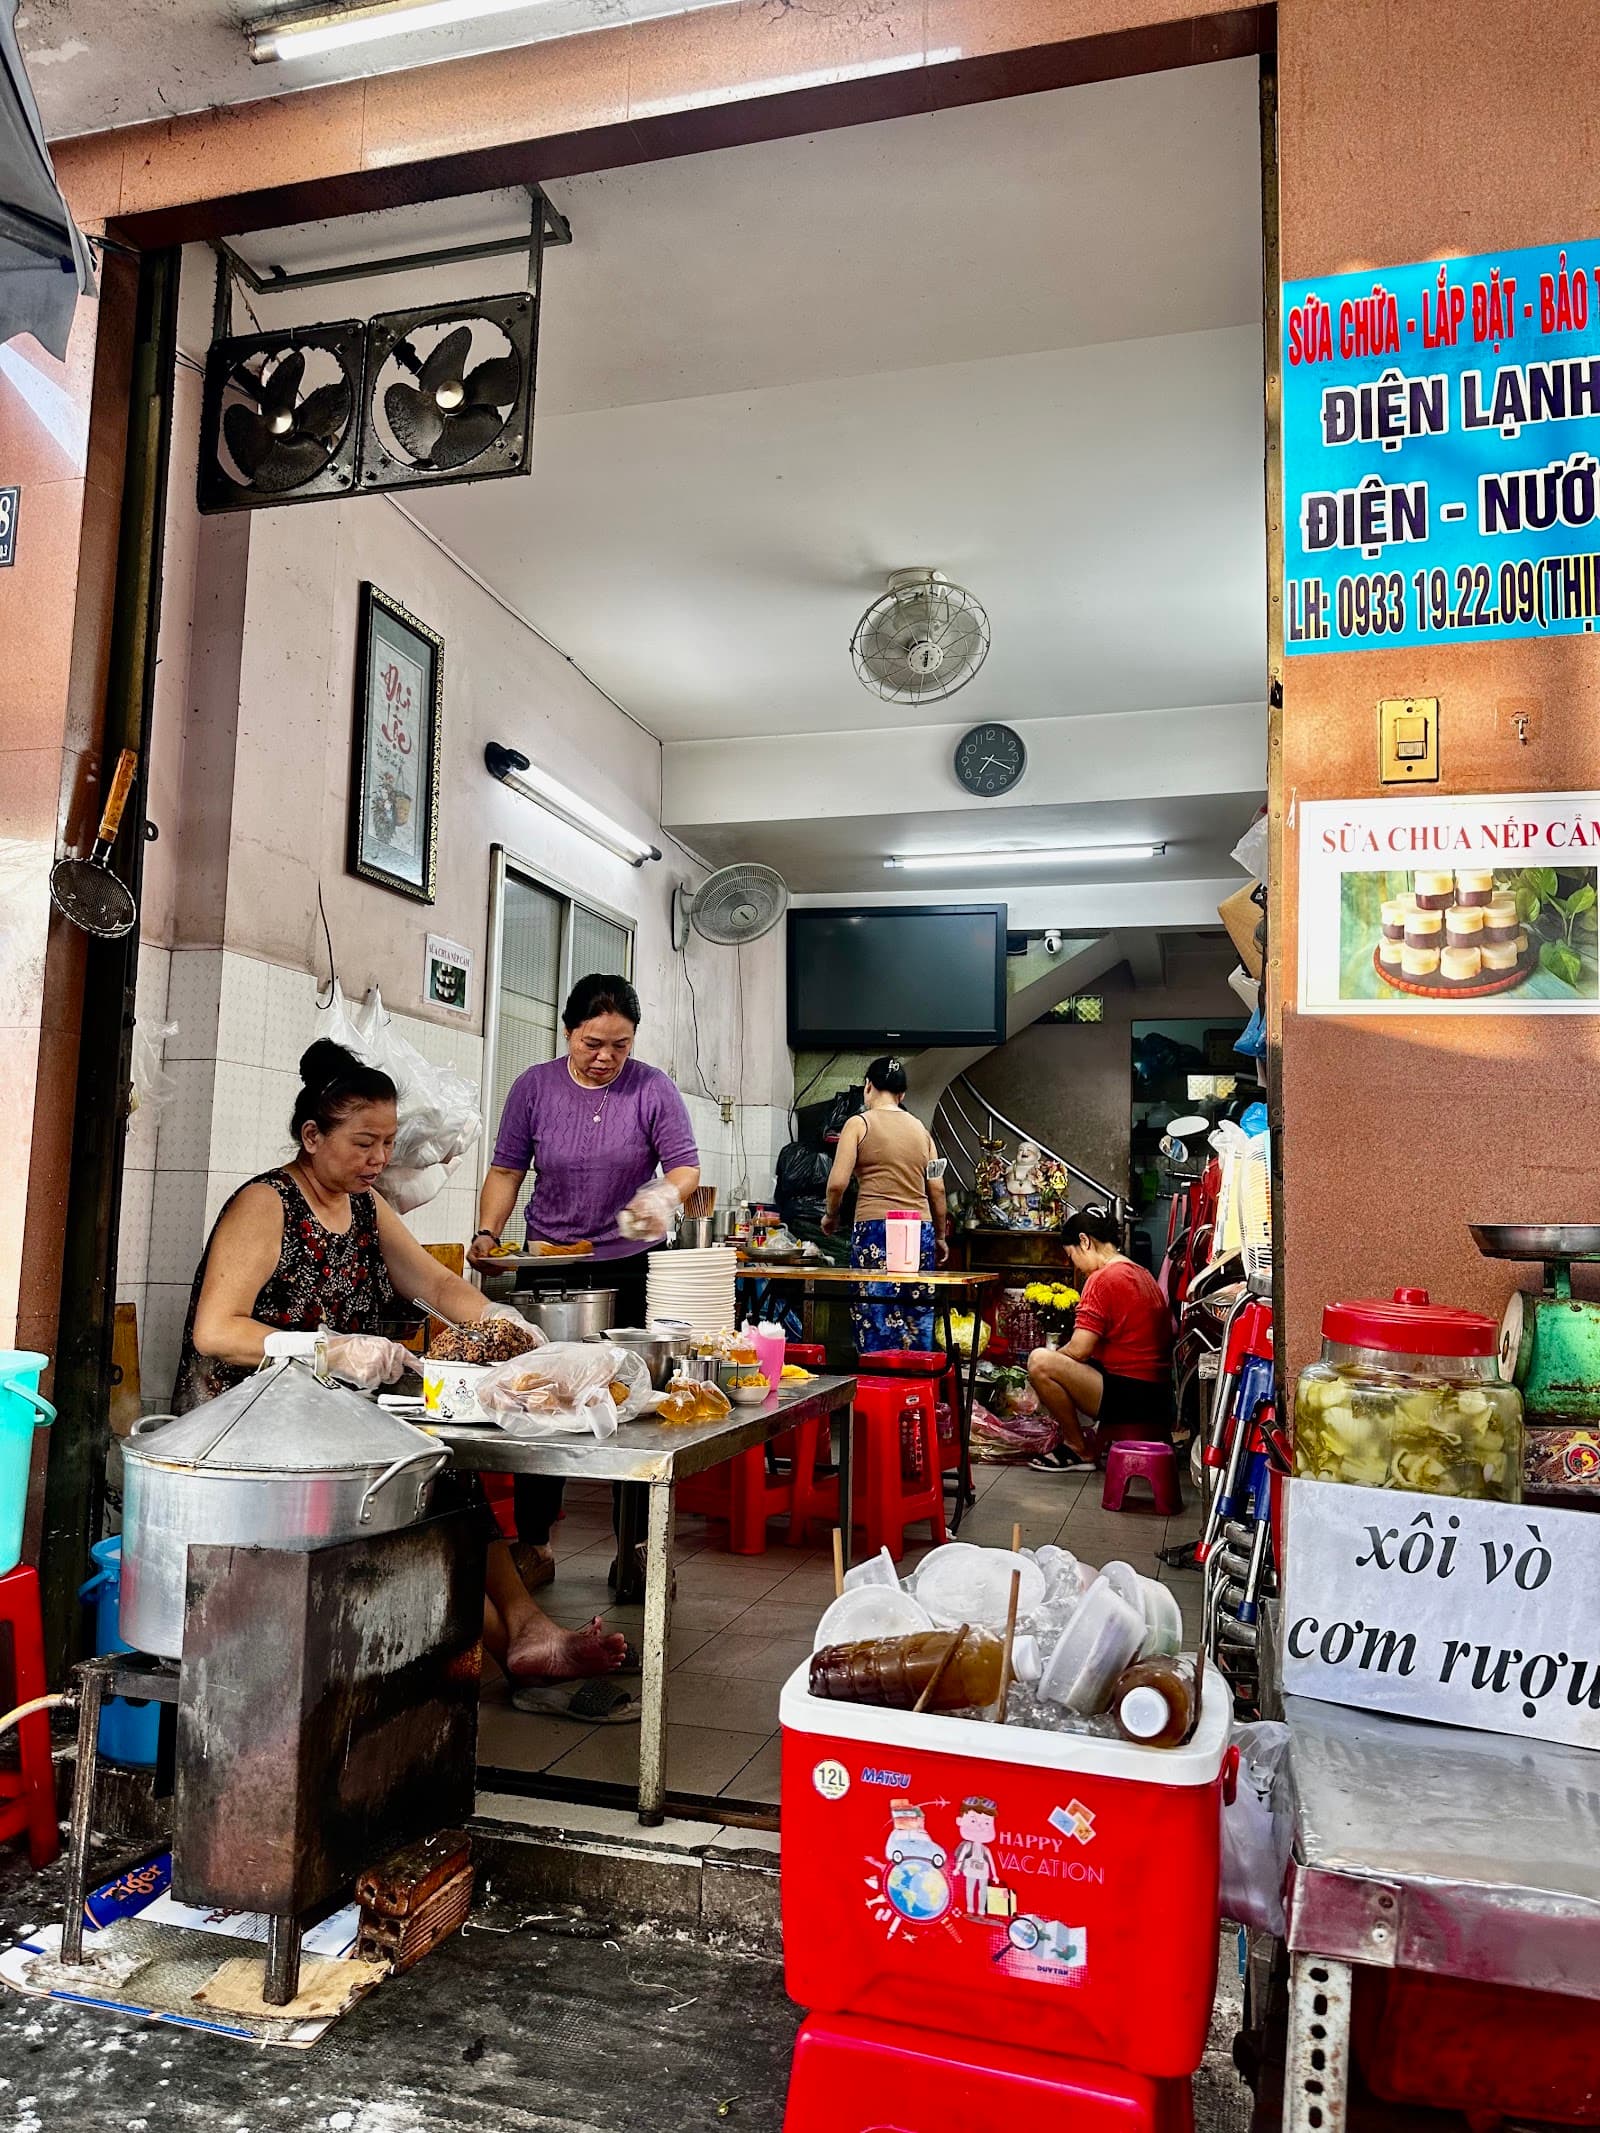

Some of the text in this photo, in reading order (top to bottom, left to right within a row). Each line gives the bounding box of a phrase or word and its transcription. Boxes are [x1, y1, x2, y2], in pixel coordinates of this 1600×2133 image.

[1288, 295, 1333, 366] SỮA
[1340, 284, 1400, 359] CHỮA
[1421, 263, 1466, 349] LẮP
[1472, 267, 1517, 354] ĐẶT
[1539, 250, 1588, 335] BẢO
[1322, 357, 1600, 451] ĐIỆN LẠNH
[1304, 479, 1428, 557] ĐIỆN
[1480, 455, 1600, 534] NƯỚ
[1289, 579, 1329, 641] LH:
[1338, 571, 1404, 637] 0933
[975, 734, 983, 745] 11
[986, 729, 996, 741] 12
[965, 744, 977, 754] 10
[1008, 740, 1016, 752] 2
[961, 756, 970, 766] 9
[1012, 752, 1019, 763] 3
[964, 769, 973, 779] 8
[1008, 766, 1016, 775] 4
[974, 776, 982, 788] 7
[986, 779, 994, 790] 6
[999, 775, 1007, 785] 5
[1321, 822, 1380, 854] SỮA
[1388, 824, 1472, 852] CHUA
[1481, 815, 1539, 849] NẾP
[1355, 1511, 1553, 1591] xôi vò
[1287, 1615, 1600, 1719] cơm rượu
[818, 1767, 846, 1787] 12L
[861, 1767, 912, 1789] MATSU
[999, 1831, 1063, 1853] HAPPY
[997, 1850, 1105, 1885] VACATION
